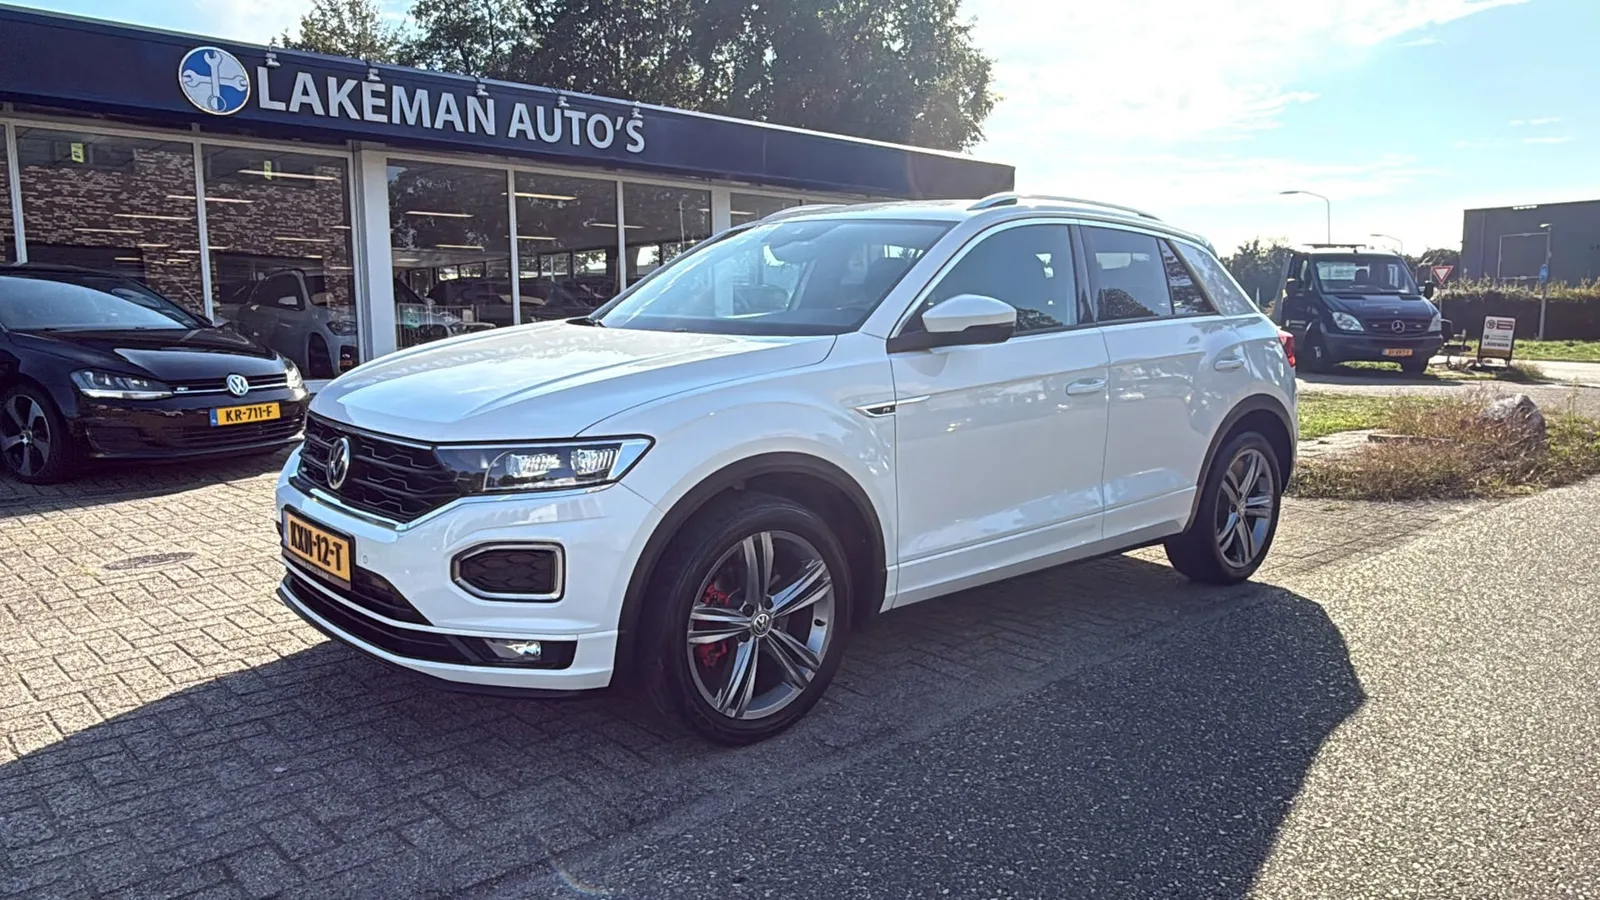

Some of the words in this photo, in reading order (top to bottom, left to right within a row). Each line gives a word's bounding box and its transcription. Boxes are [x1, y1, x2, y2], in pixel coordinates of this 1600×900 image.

[257, 66, 496, 136] LAKEMAN
[508, 102, 645, 153] AUTO'S
[225, 405, 272, 422] KR-711-F
